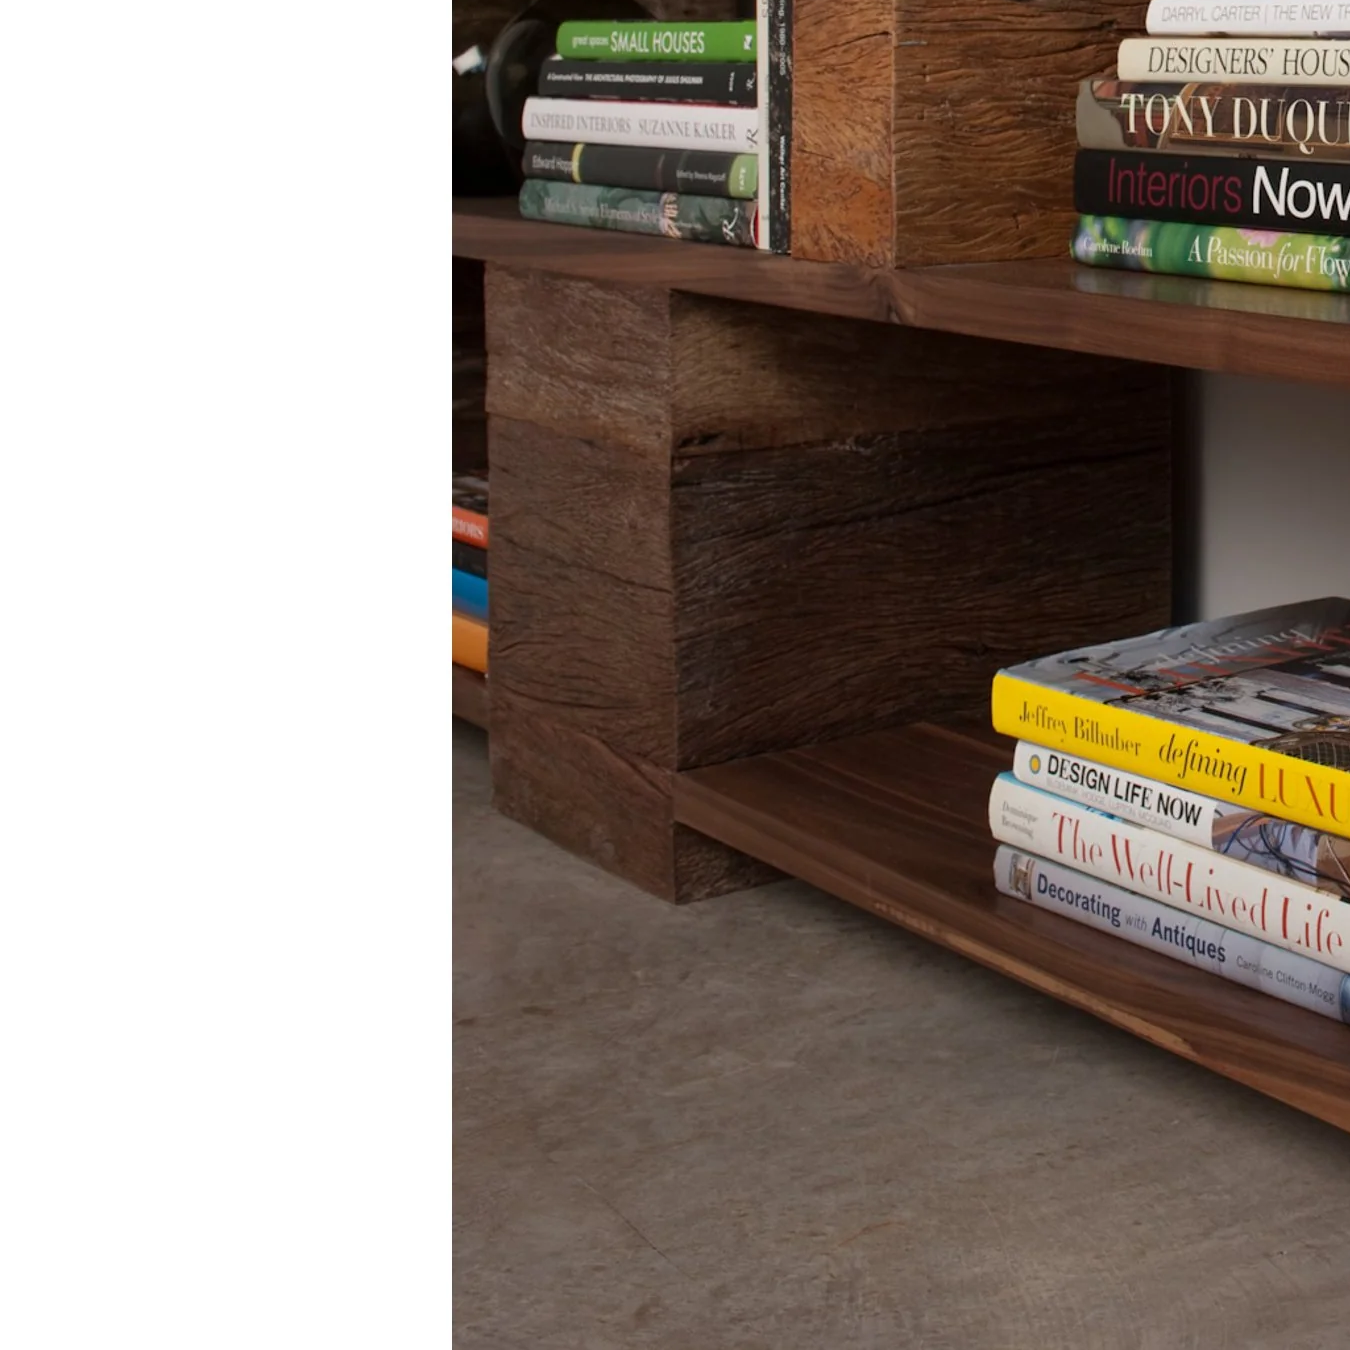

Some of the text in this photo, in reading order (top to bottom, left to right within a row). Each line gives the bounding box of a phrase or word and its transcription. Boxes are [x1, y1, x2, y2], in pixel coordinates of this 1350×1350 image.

[1161, 5, 1208, 22] DARRYL
[1210, 4, 1261, 22] CARTER
[1272, 4, 1299, 21] THE
[1300, 4, 1335, 21] NEW
[610, 31, 650, 53] SMALL
[652, 31, 706, 54] HOUSES
[1148, 46, 1274, 76] DESIGNERS'
[530, 113, 736, 141] INSPIRED INTERIORS SUZANNE KASLER
[1120, 92, 1222, 138] TONY
[532, 154, 556, 171] Edward
[1108, 158, 1242, 213] Interiors
[1083, 236, 1121, 259] Carolyne
[1121, 240, 1153, 258] Roehm
[1187, 235, 1203, 263] A
[1206, 237, 1274, 270] Passion
[1273, 242, 1304, 280] for
[1019, 701, 1068, 743] Jeffrey
[1074, 716, 1142, 757] Bilhuber
[1159, 733, 1248, 796] defining
[1047, 754, 1203, 827] DESIGN LIFE NOW
[1052, 812, 1342, 956] The Well-Lived Life
[1037, 872, 1121, 928] Decorating
[1124, 911, 1149, 933] with
[1151, 917, 1227, 965] Antiques
[1235, 955, 1274, 980] Caroline
